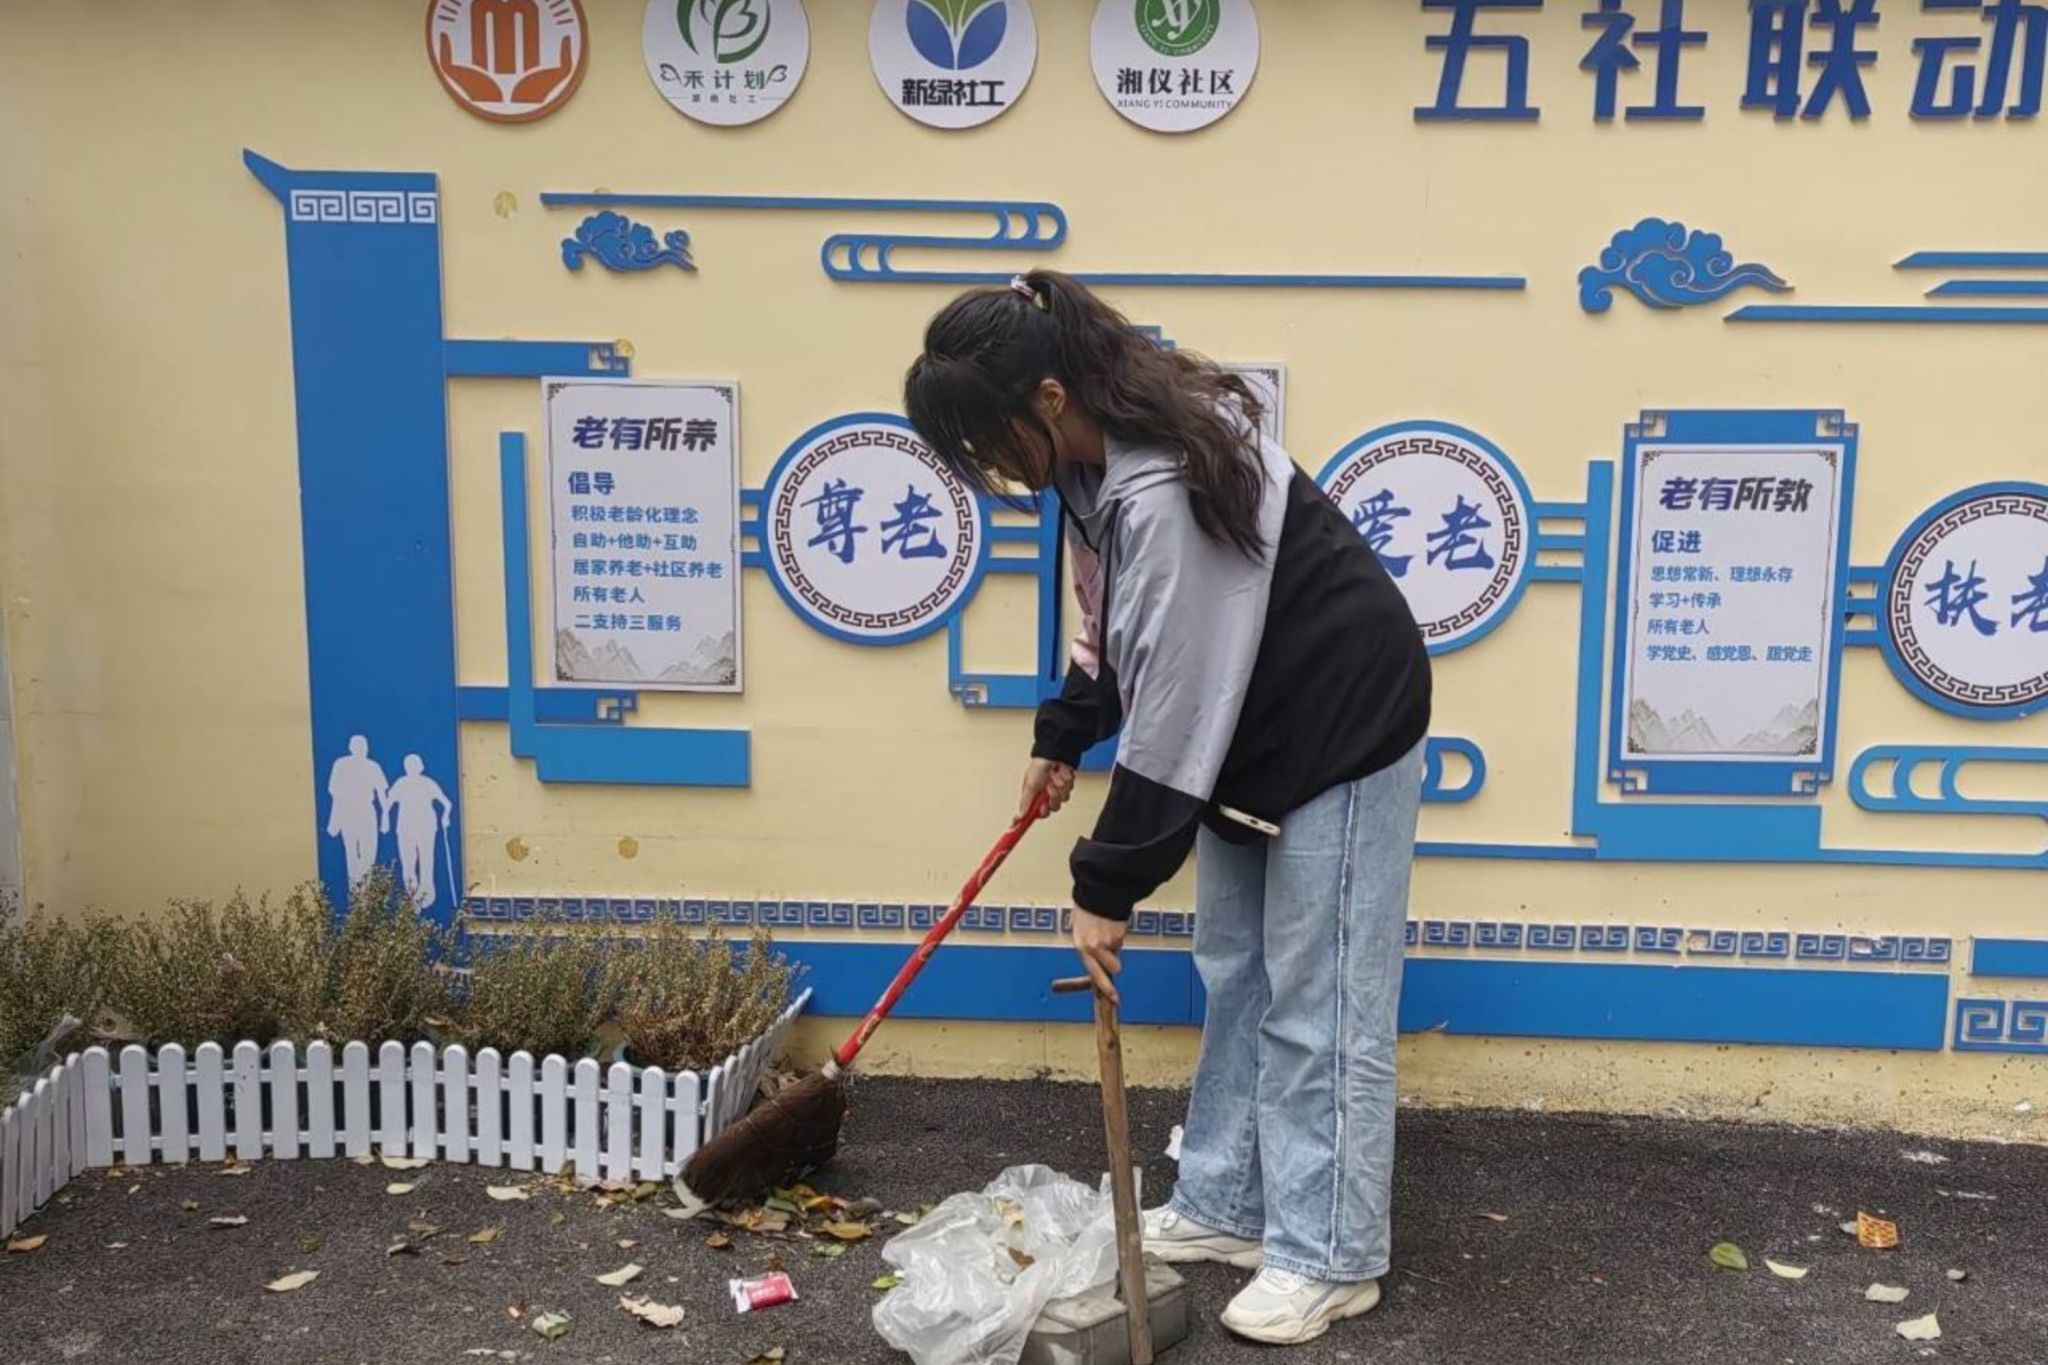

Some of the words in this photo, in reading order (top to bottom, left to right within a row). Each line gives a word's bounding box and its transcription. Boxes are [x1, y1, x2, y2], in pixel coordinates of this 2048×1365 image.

[1414, 0, 2048, 122] 五社联动
[683, 69, 765, 90] 禾计划
[1116, 67, 1234, 96] 湘仪社区
[901, 78, 1005, 107] 新绿社工
[1118, 99, 1151, 109] XIANG
[1153, 99, 1164, 109] YI
[1165, 99, 1233, 109] COMMUNITY
[572, 416, 717, 452] 老有所养
[568, 471, 616, 495] 倡导
[1659, 476, 1814, 512] 老有所教
[571, 505, 699, 524] 积极老龄化理念
[800, 478, 947, 564] 尊老
[573, 532, 697, 551] 自助+他助+互助
[1353, 488, 1495, 578] 爱老
[1651, 529, 1701, 554] 促进
[573, 559, 723, 579] 居家养老+社区养老
[573, 585, 645, 604] 所有老人
[1648, 592, 1722, 609] 学习+传承
[574, 613, 682, 633] 二支持三服务
[1646, 618, 1710, 636] 所有老人
